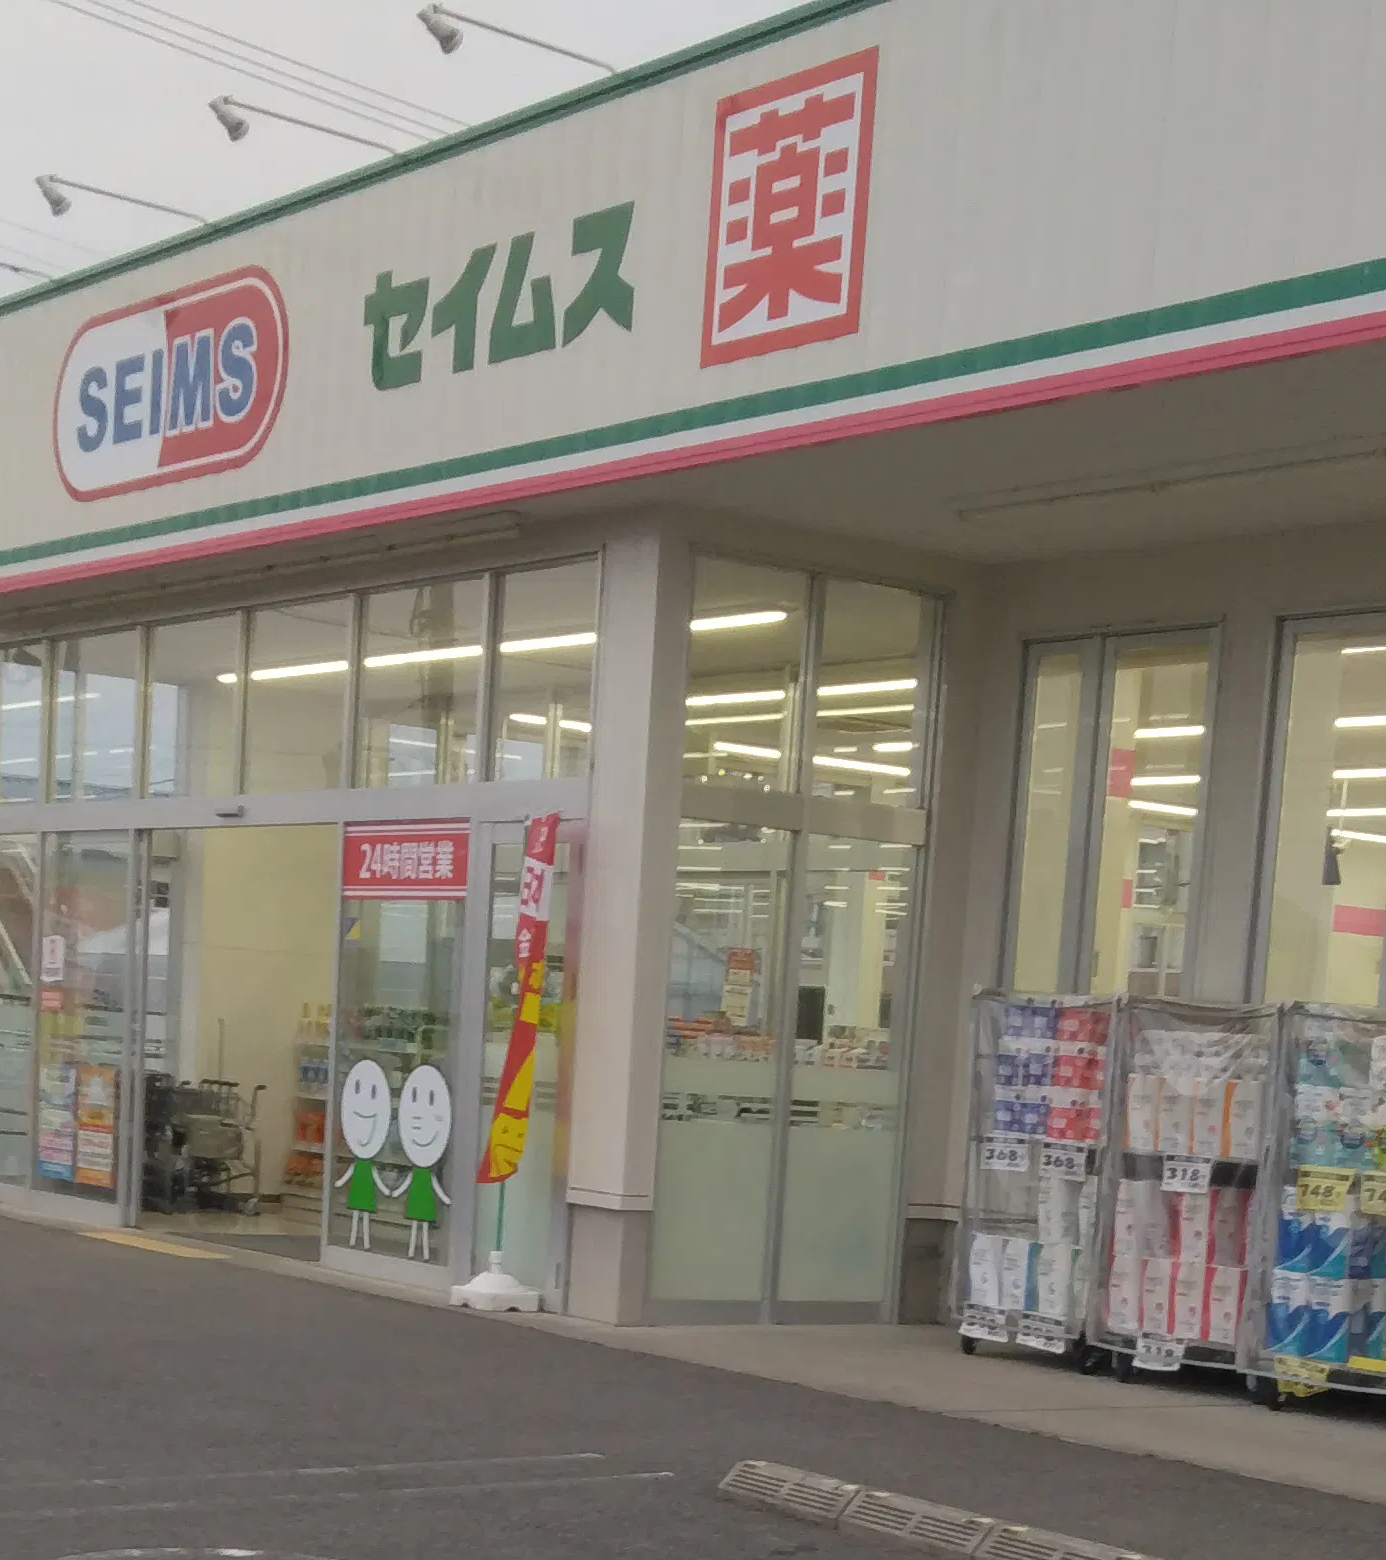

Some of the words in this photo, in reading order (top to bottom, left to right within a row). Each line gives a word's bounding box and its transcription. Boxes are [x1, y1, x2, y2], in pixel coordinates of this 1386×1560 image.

[362, 200, 636, 392] セイムス
[716, 92, 856, 336] 薬
[76, 317, 257, 455] SEIMS
[358, 840, 454, 880] 24時間営業
